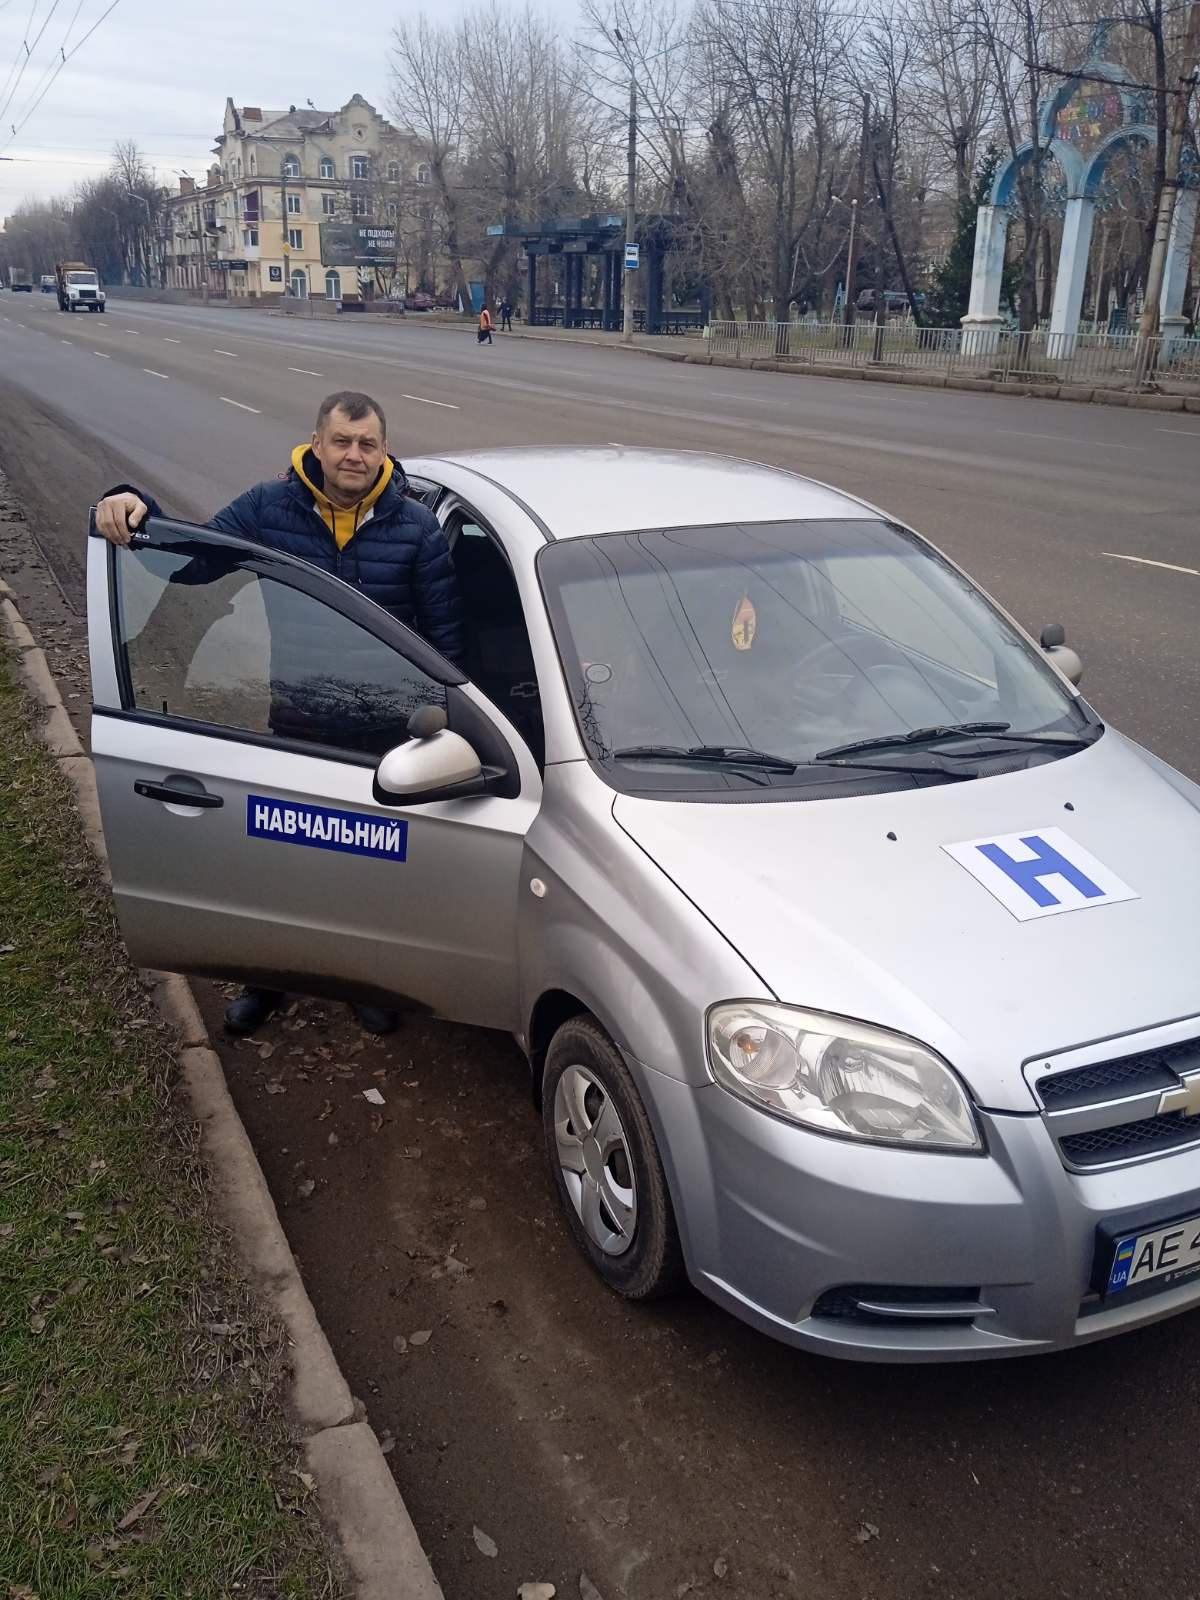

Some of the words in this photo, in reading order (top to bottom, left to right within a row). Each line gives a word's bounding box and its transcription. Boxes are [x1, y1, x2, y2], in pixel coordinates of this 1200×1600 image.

[255, 804, 400, 853] НАВЧАЛЬНИЙ
[975, 835, 1107, 908] Н
[1112, 1271, 1127, 1284] UA
